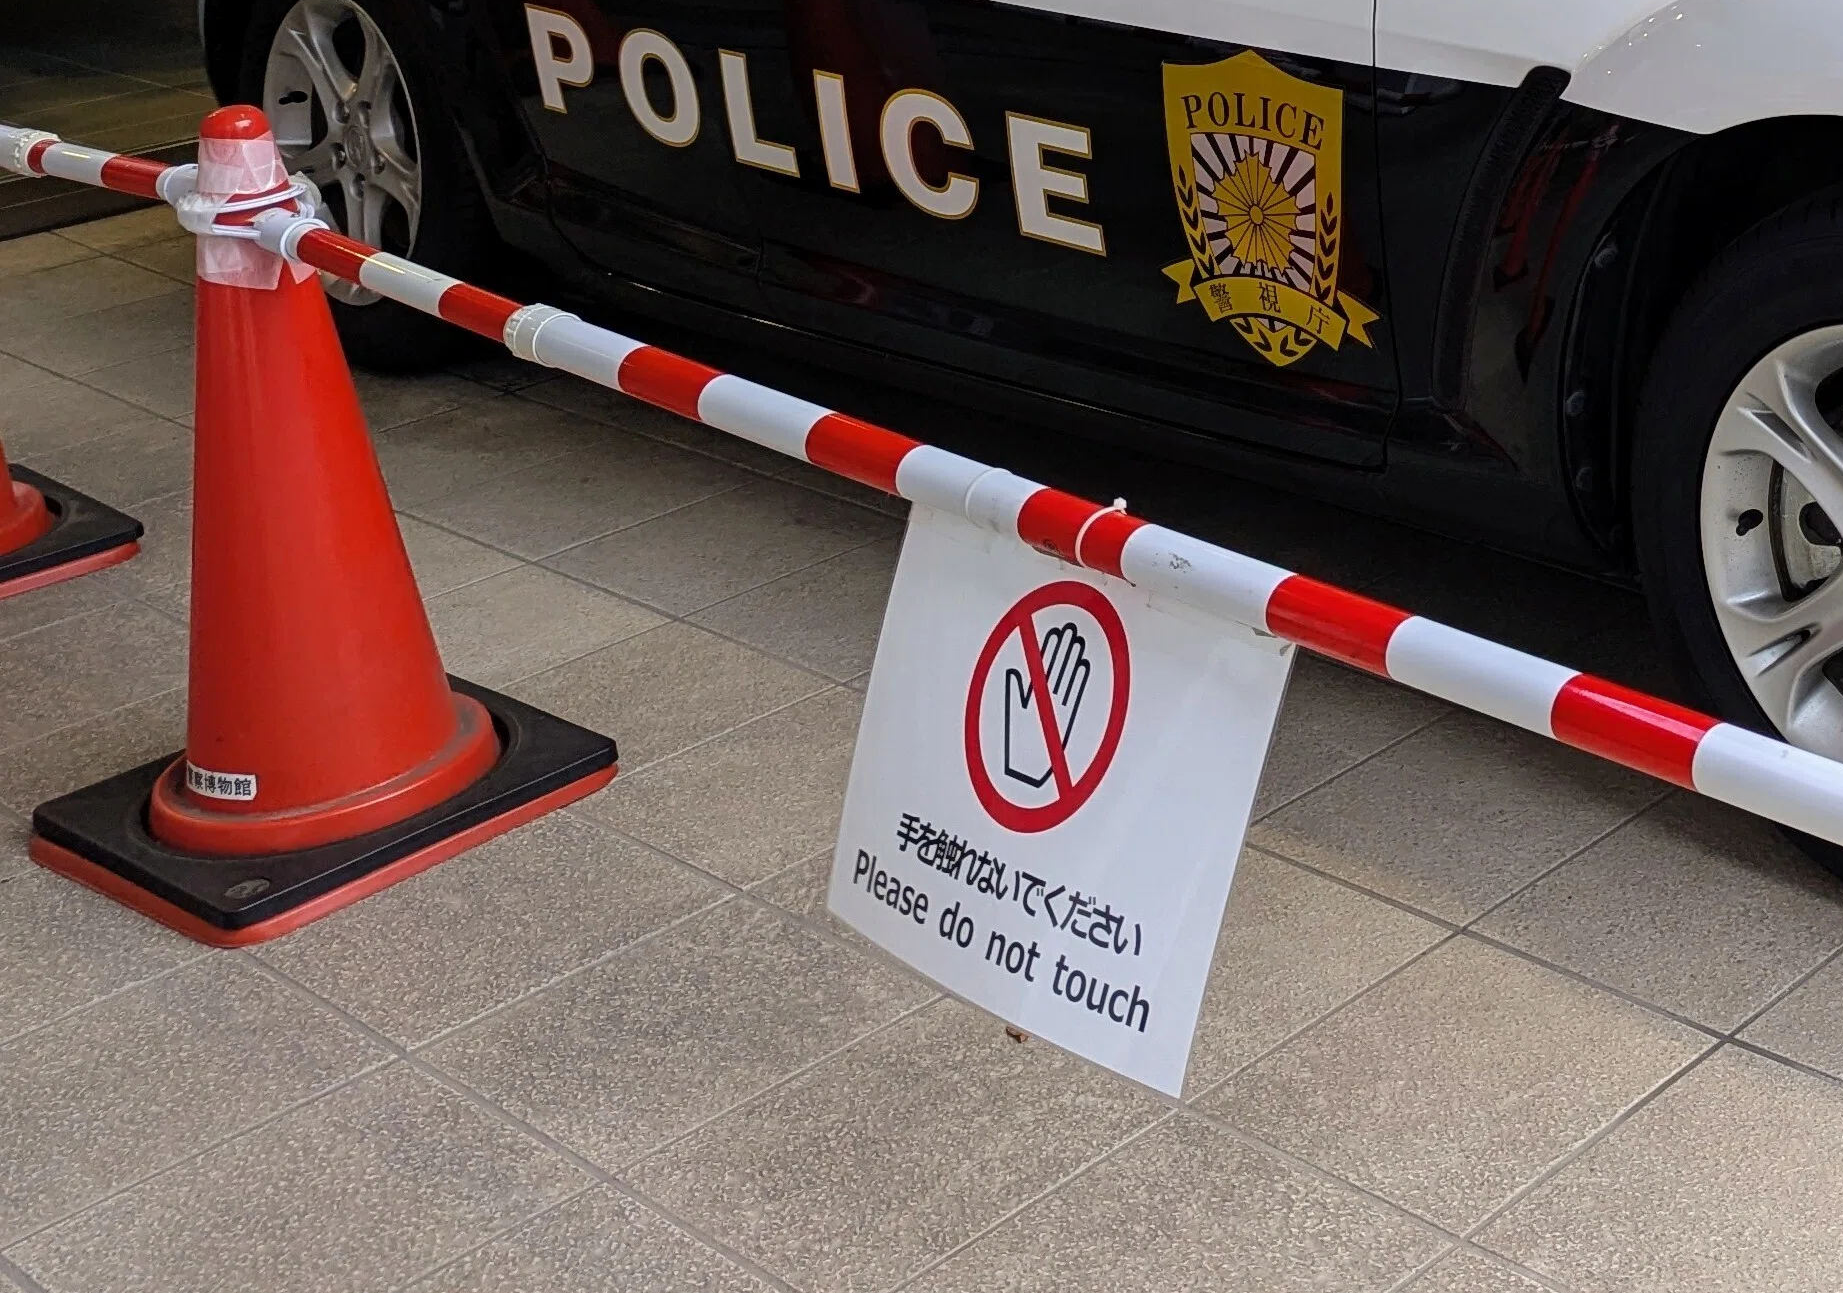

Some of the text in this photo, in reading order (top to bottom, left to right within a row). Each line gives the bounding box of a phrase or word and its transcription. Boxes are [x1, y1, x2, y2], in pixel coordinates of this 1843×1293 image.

[524, 3, 1106, 256] POLICE
[1181, 91, 1325, 151] POLICE
[1209, 282, 1331, 335] 警視庁
[853, 848, 1150, 1033] Please do not touch
[897, 812, 1142, 956] 手を触れないでください
